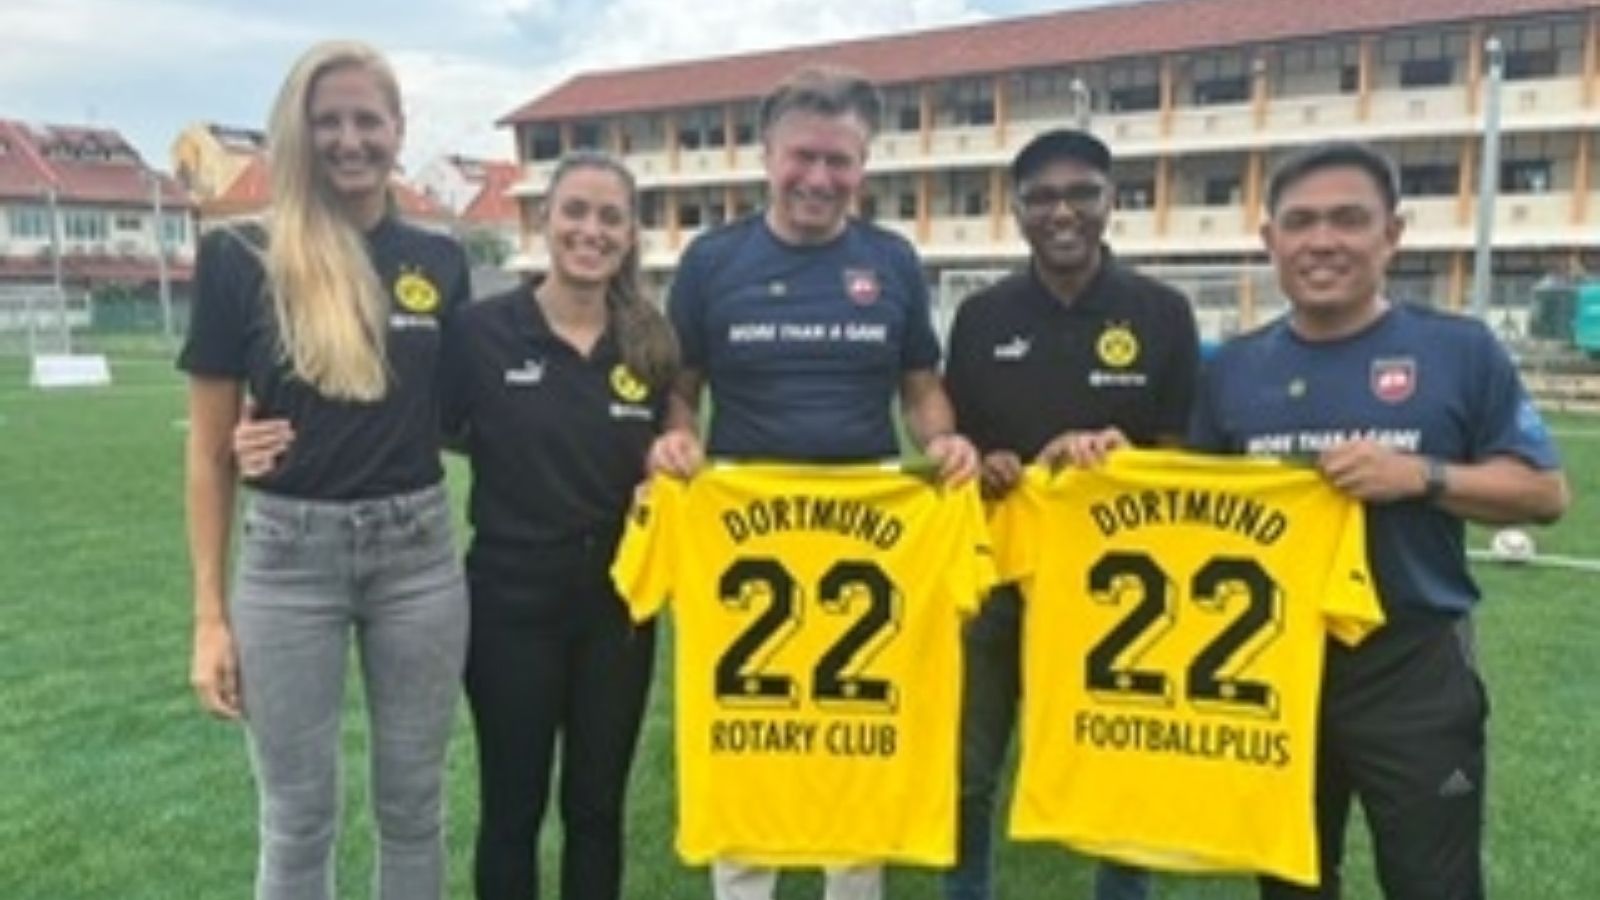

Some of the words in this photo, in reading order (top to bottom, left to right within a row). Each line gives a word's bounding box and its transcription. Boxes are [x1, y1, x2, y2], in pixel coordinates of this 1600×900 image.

[722, 496, 904, 549] DORTMUND
[1089, 489, 1288, 545] DORTMUND
[714, 556, 905, 715] 22
[1084, 550, 1286, 720] 22
[711, 719, 817, 757] ROTARY
[825, 720, 897, 757] CLUB
[1075, 712, 1291, 768] FOOTBALLPLUS
